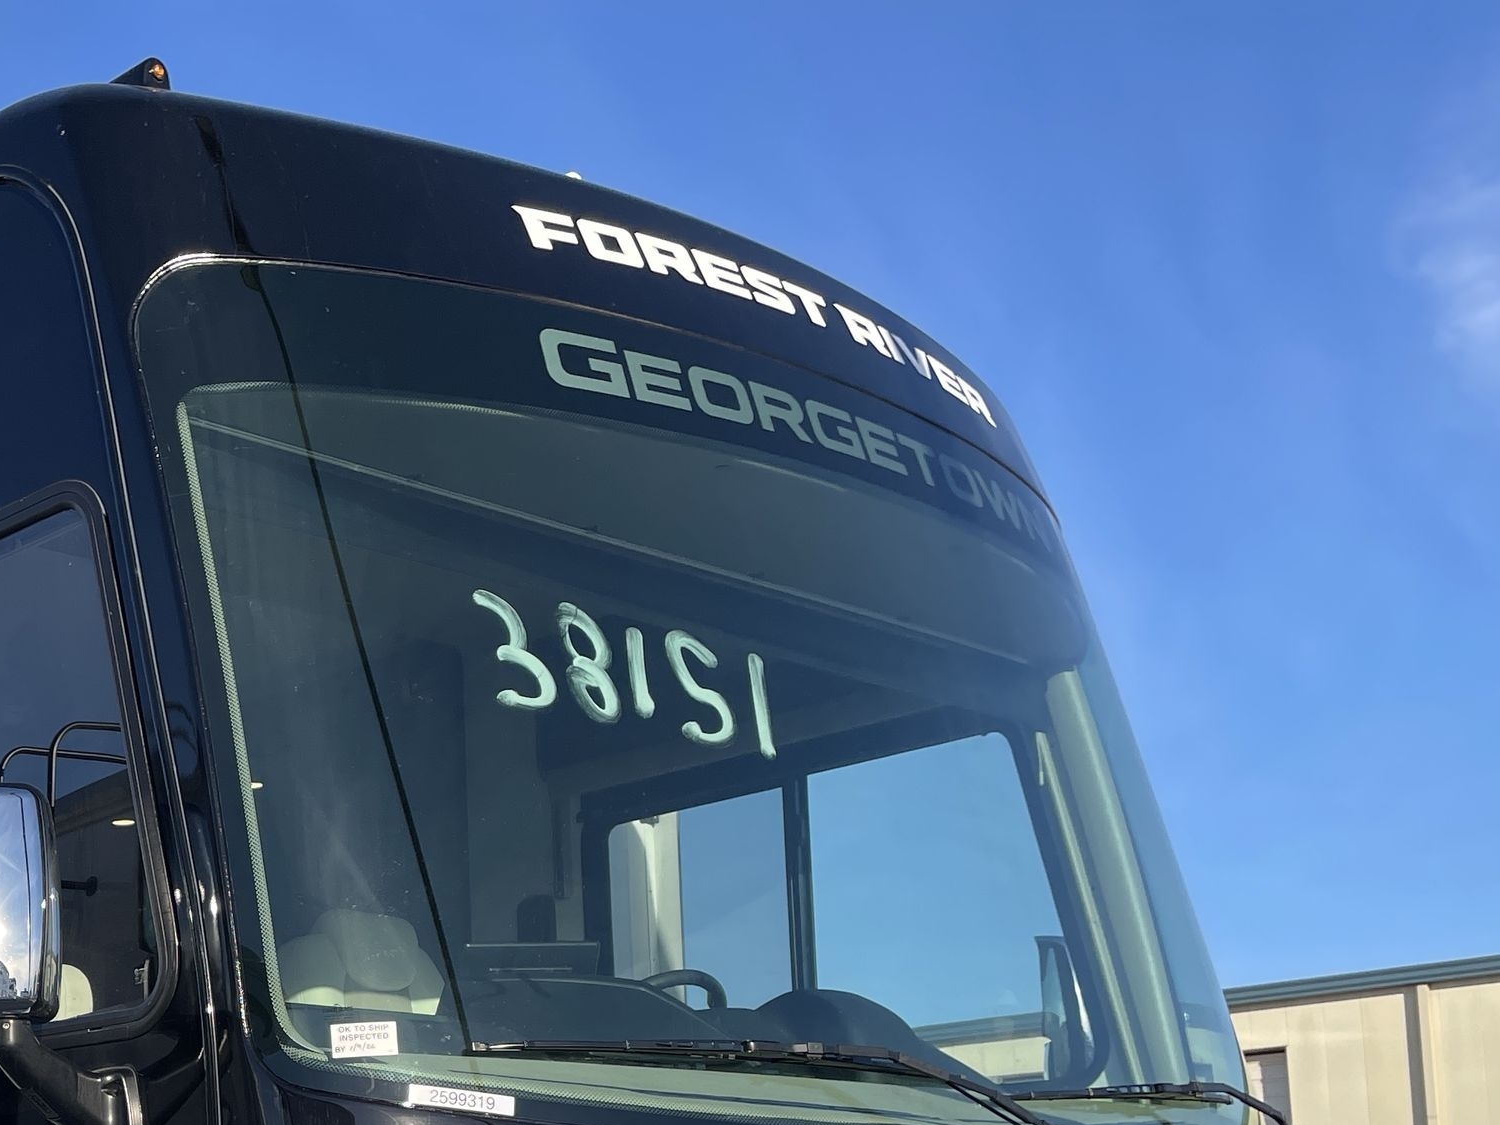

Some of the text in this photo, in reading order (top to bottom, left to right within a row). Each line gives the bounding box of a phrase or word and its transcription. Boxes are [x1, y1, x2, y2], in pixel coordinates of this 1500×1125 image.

[510, 203, 998, 429] FOREST RIVER
[538, 327, 1054, 553] GEORGETOWN
[339, 1032, 389, 1042] INSPECTED
[368, 1023, 389, 1031] SHIP
[429, 1089, 496, 1111] 2599319
